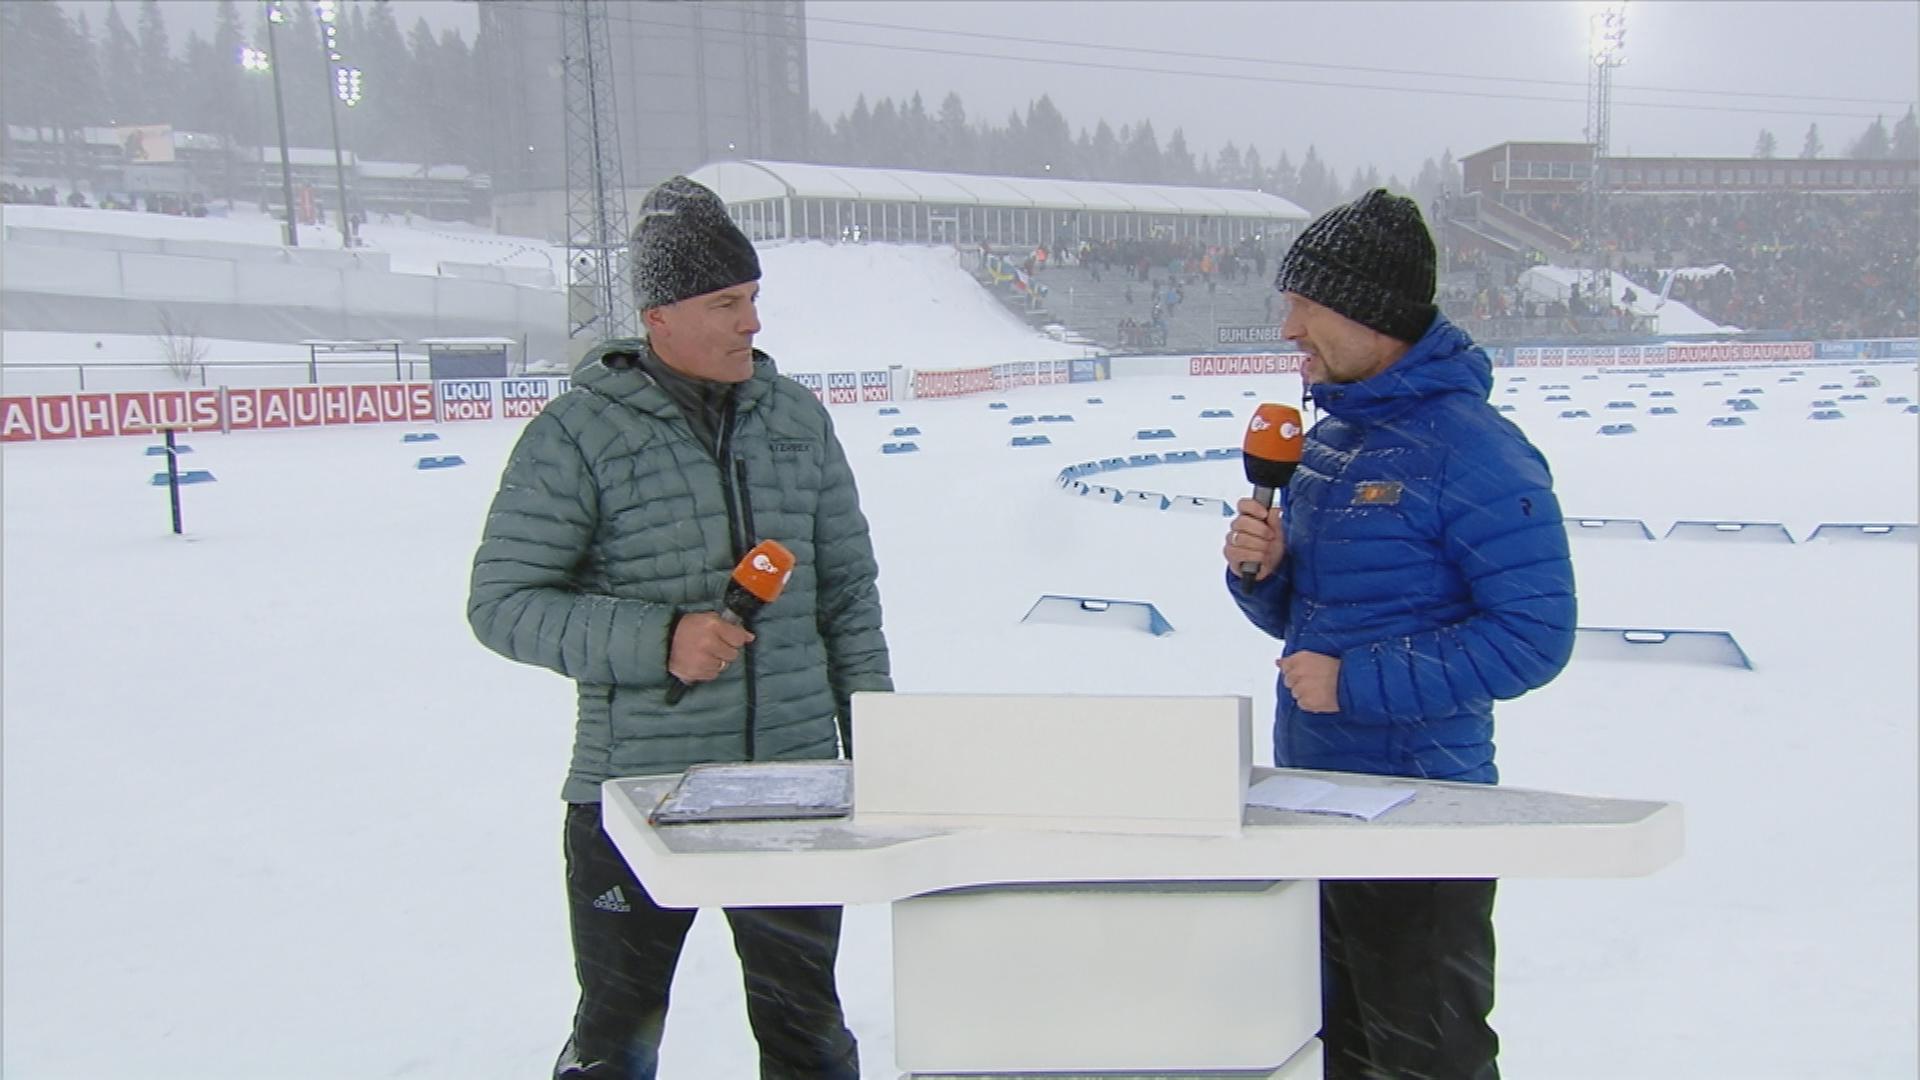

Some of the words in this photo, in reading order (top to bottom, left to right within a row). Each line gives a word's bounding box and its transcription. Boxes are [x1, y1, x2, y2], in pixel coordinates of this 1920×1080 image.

[1220, 328, 1281, 341] BUHLENBE
[1669, 346, 1740, 363] BAUHAUS
[1743, 343, 1811, 360] BAUHAUS
[1192, 358, 1275, 373] BAUHAUS
[831, 374, 855, 388] LIQUI
[863, 372, 887, 386] LIQUI
[443, 382, 490, 399] LIQUI
[503, 381, 548, 398] LIQUI
[831, 388, 857, 402] MOLY
[864, 387, 888, 401] MOLY
[231, 387, 431, 424] BAUHAUS
[445, 402, 492, 419] MOLY
